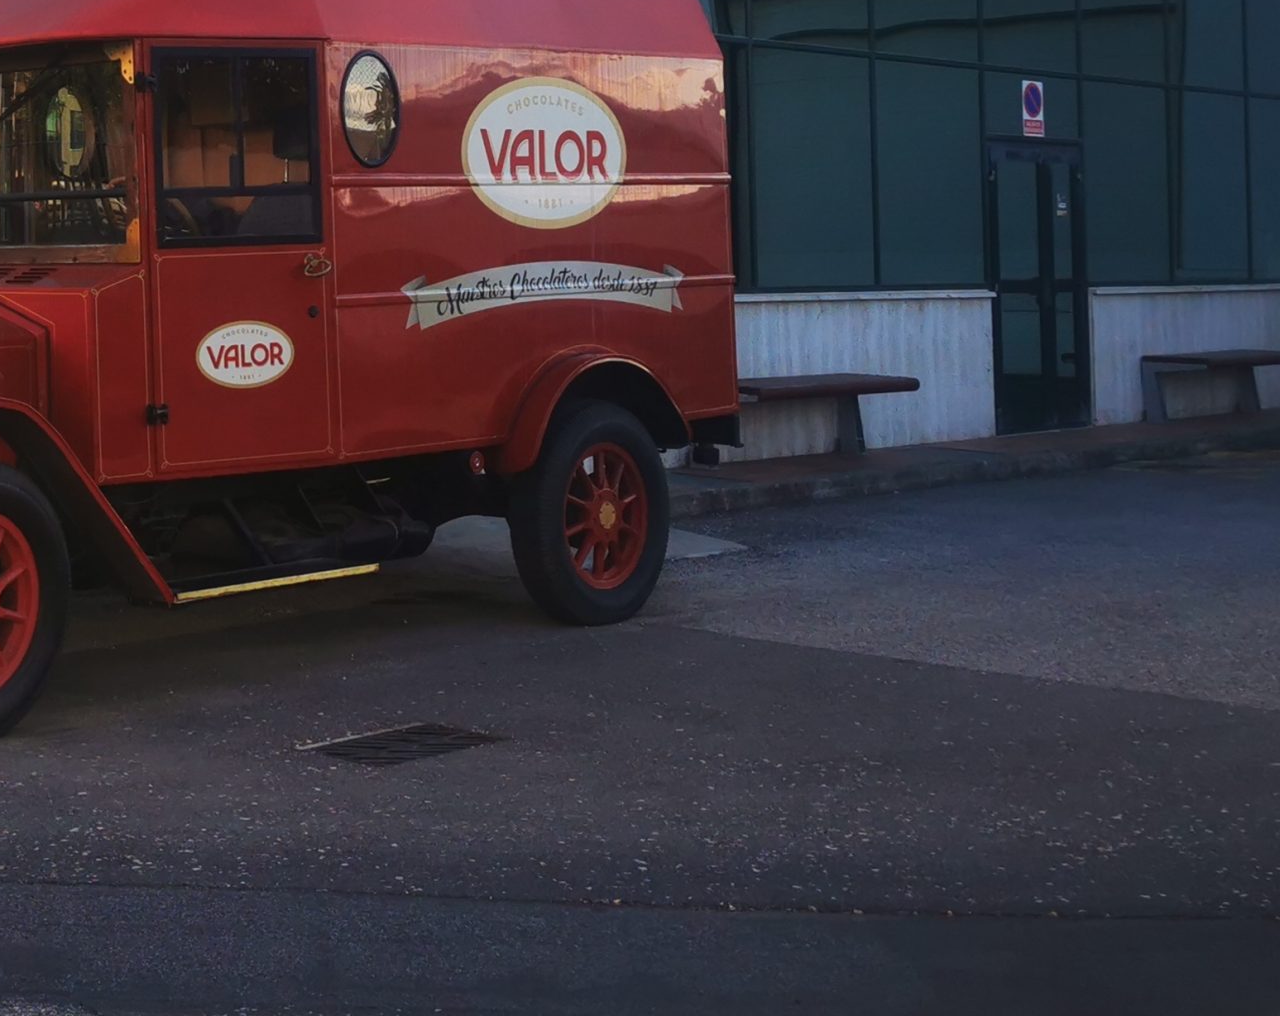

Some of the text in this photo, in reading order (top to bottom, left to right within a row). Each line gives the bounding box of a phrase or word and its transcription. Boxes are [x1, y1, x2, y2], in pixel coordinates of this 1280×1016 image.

[506, 95, 585, 116] CHOCOLATES
[479, 128, 610, 182] VALOR
[509, 267, 589, 301] Chocolateros
[592, 268, 626, 292] desde
[206, 342, 285, 369] VALOR
